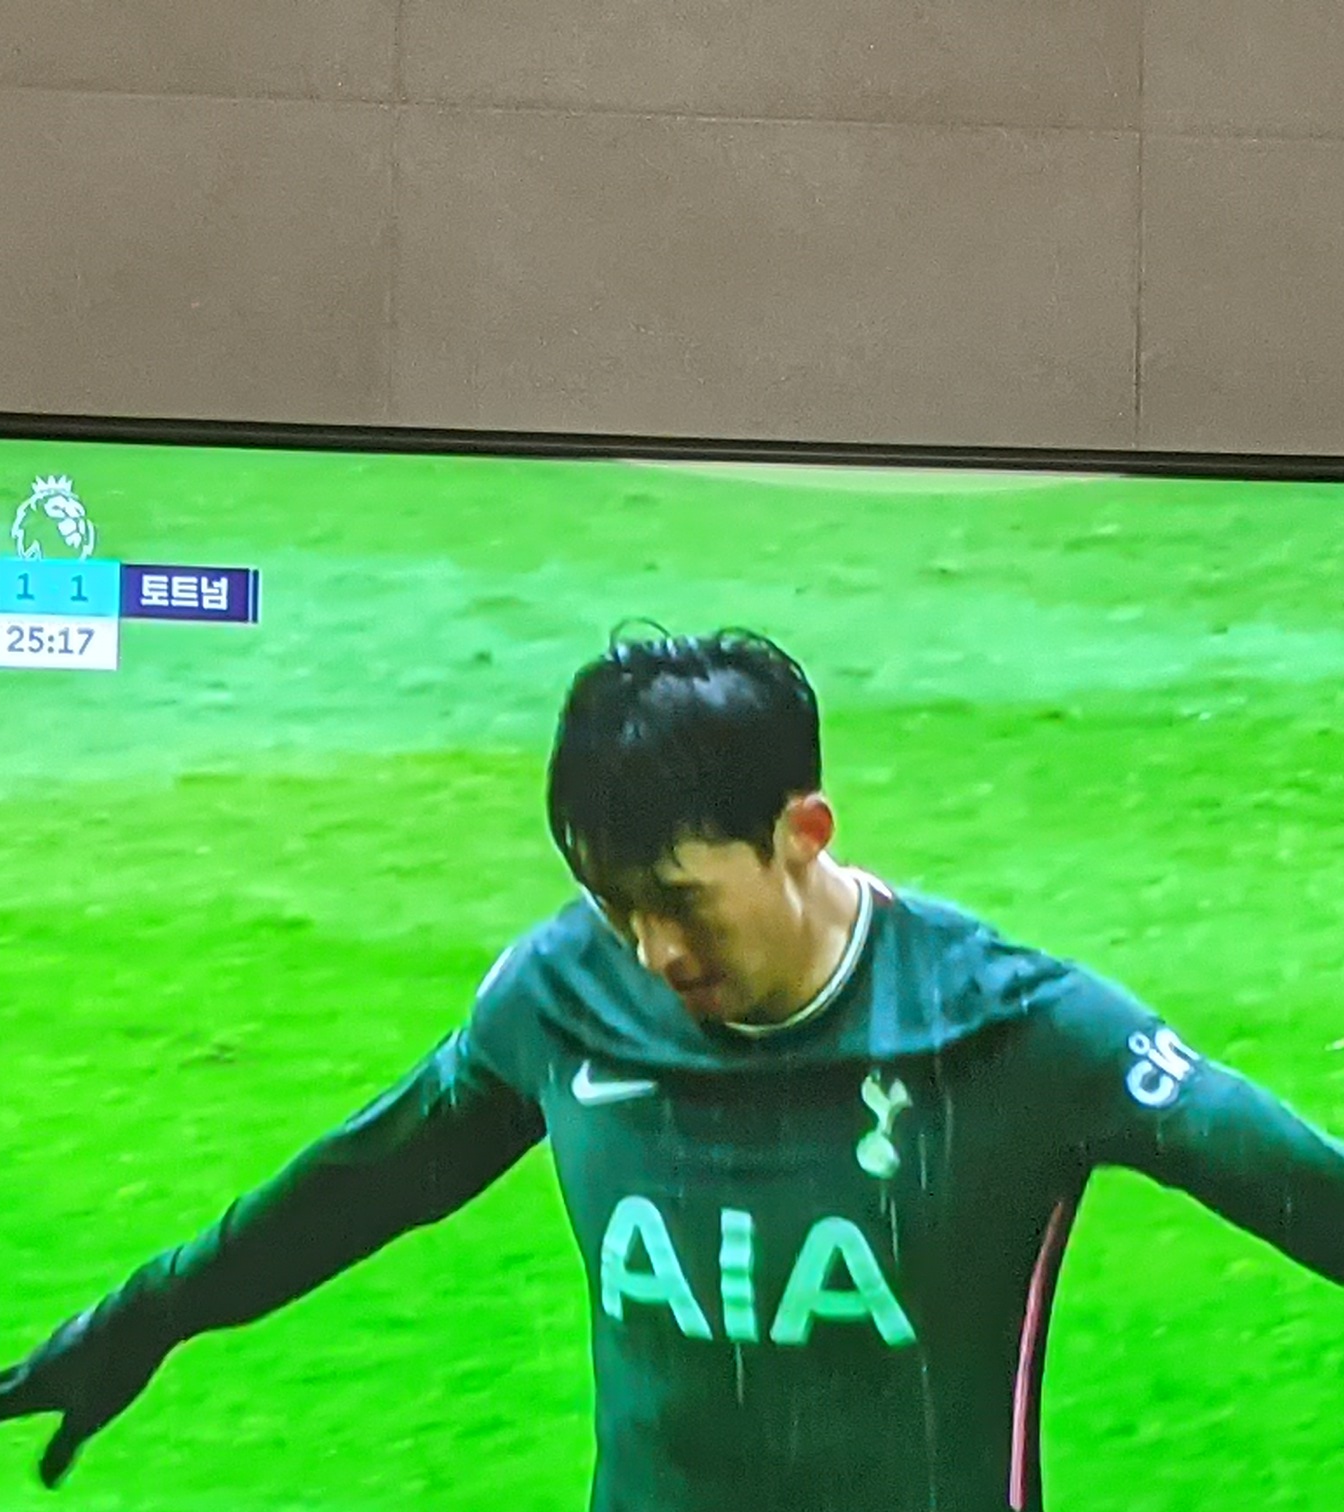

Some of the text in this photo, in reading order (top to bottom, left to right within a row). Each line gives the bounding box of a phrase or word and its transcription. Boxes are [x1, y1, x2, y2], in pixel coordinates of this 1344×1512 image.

[16, 572, 89, 602] 1 1
[140, 574, 228, 611] 토트넘
[6, 624, 95, 656] 25:17
[600, 1194, 917, 1347] AIA
